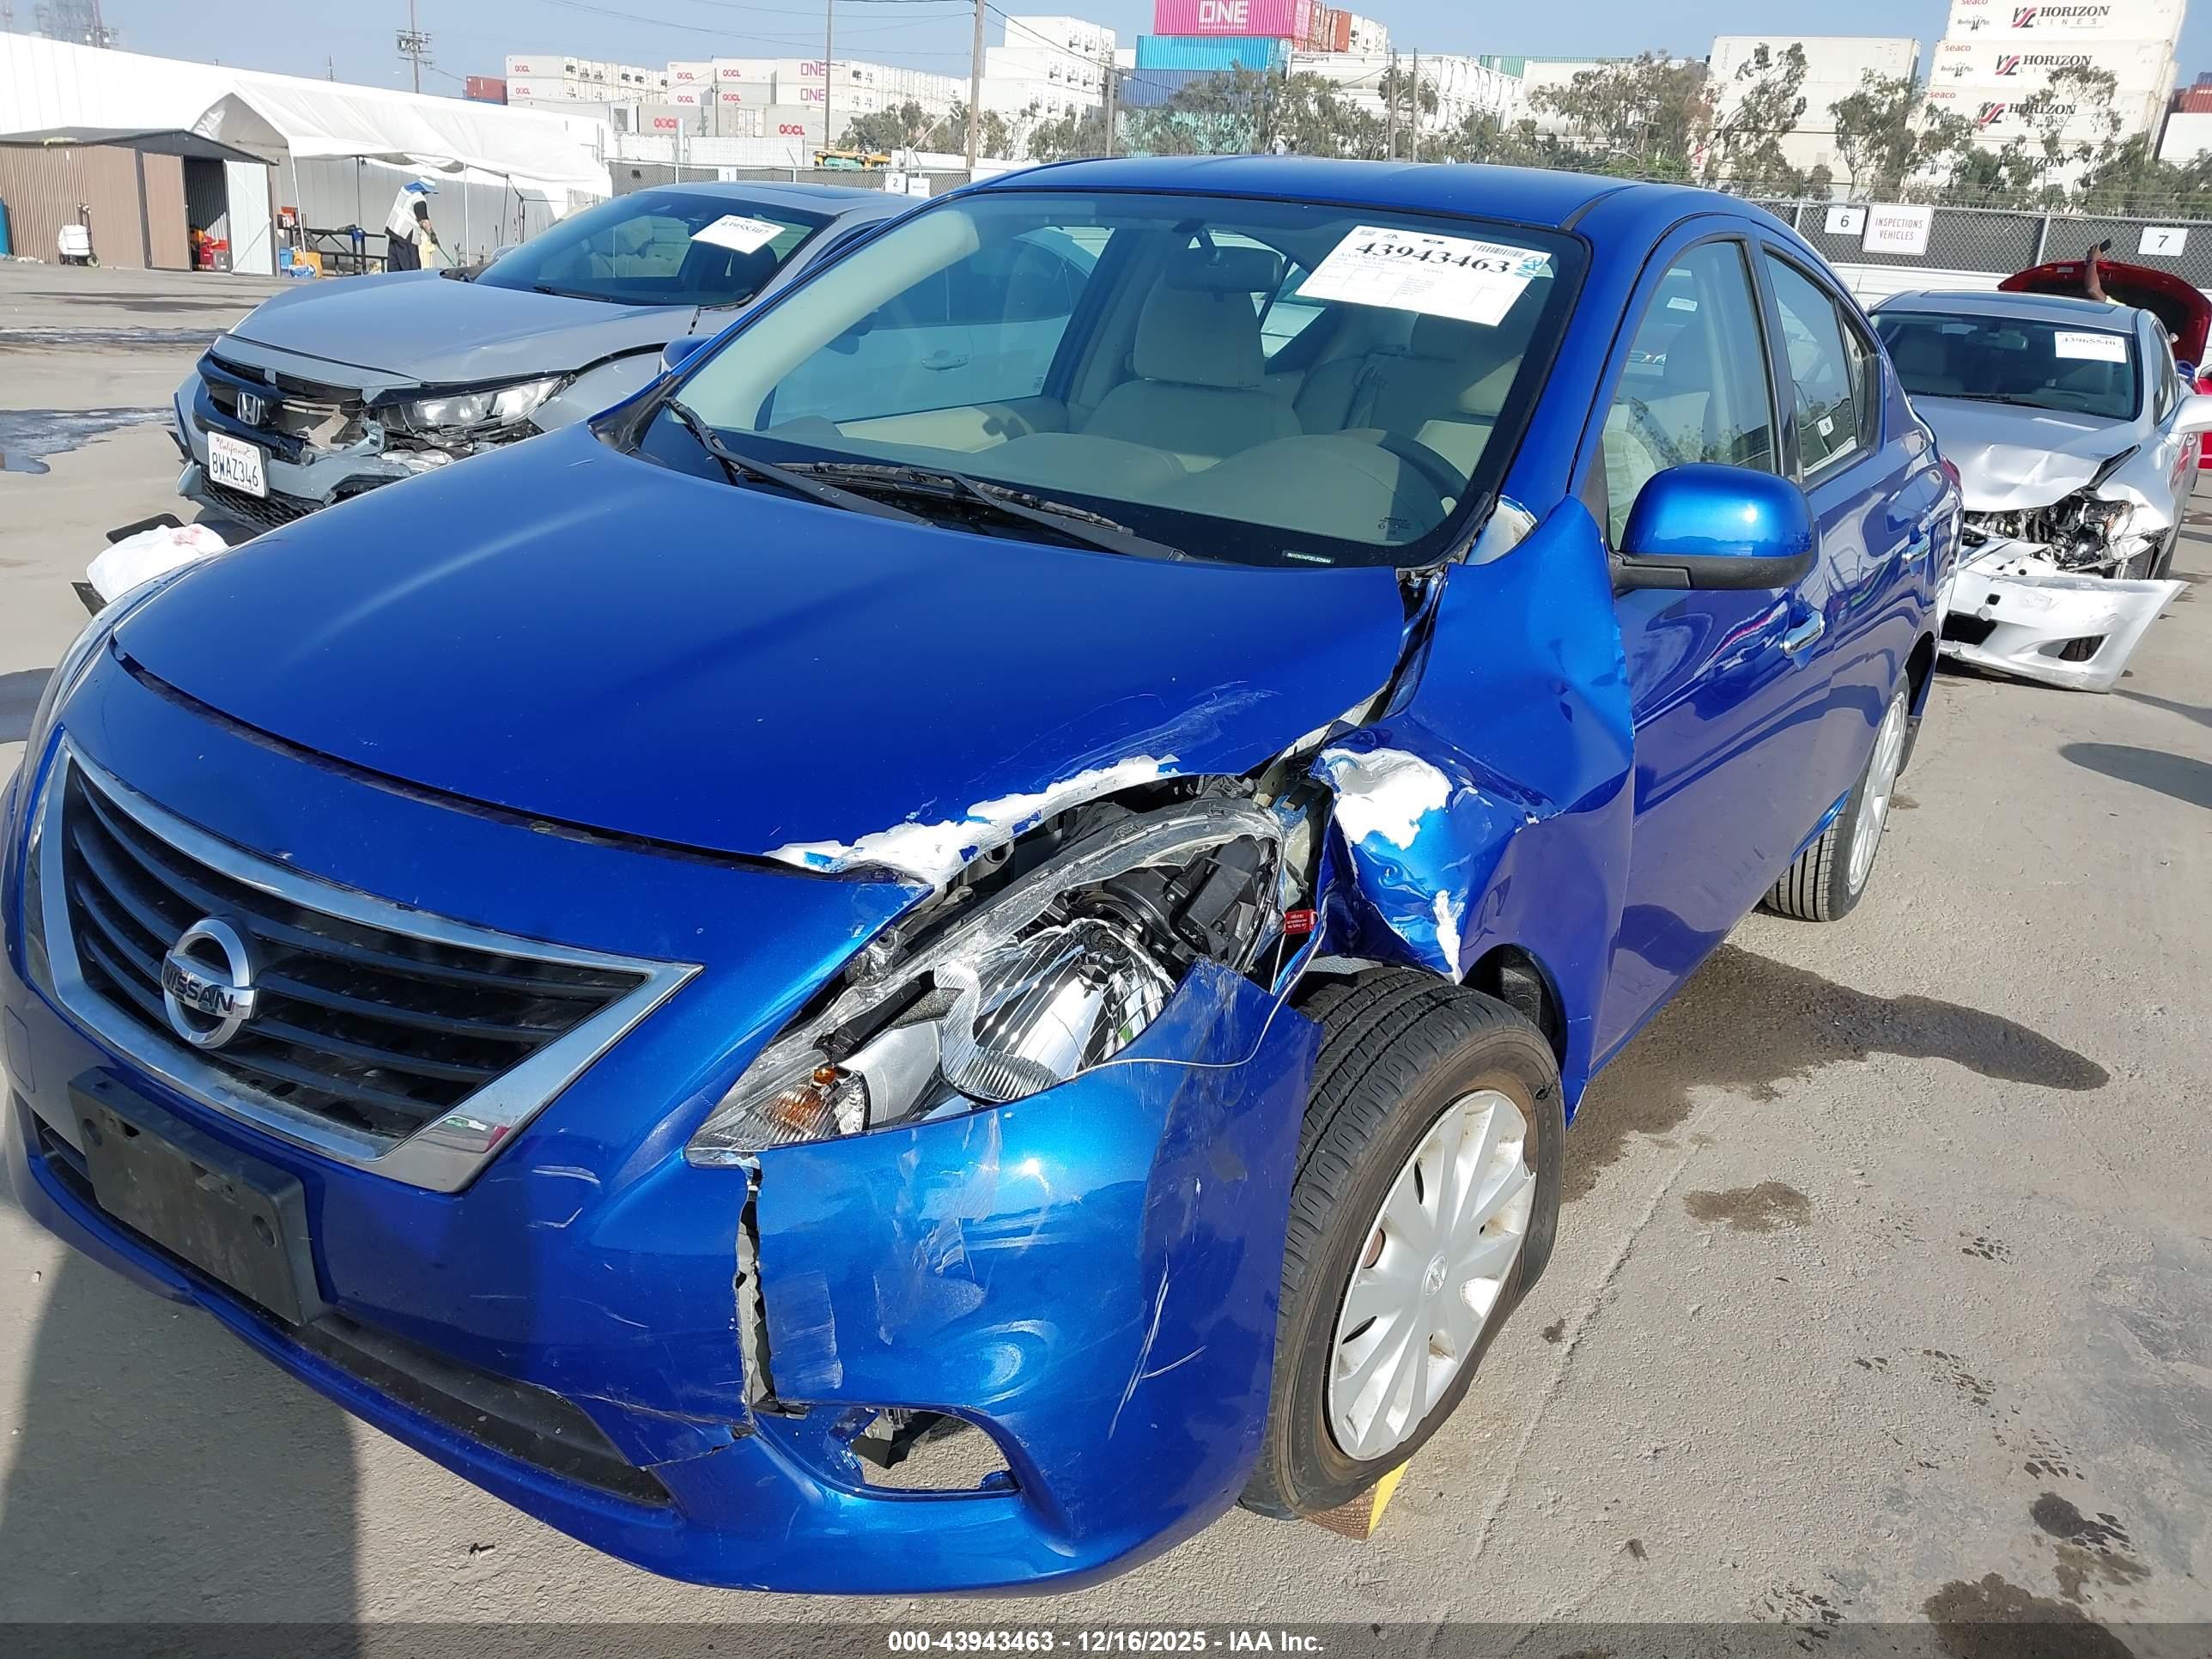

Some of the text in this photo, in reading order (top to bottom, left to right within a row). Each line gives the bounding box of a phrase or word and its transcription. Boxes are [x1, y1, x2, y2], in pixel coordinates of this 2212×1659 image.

[1199, 0, 1249, 23] ONE
[2039, 5, 2111, 17] HORIZON
[2022, 55, 2093, 66] HORIZON
[722, 69, 741, 77] OOCL
[800, 63, 826, 76] ONE
[800, 88, 825, 101] ONE
[2008, 103, 2077, 114] HORIZON
[779, 124, 805, 135] OOCL
[893, 177, 898, 187] 2
[1840, 215, 1850, 228] 6
[1875, 217, 1923, 229] INSPECTIONS
[1879, 229, 1914, 240] VEHICLES
[2158, 234, 2169, 248] 7
[1355, 242, 1510, 274] 43943463
[212, 452, 258, 487] 8WAZ346
[163, 963, 234, 1015] NISSAN
